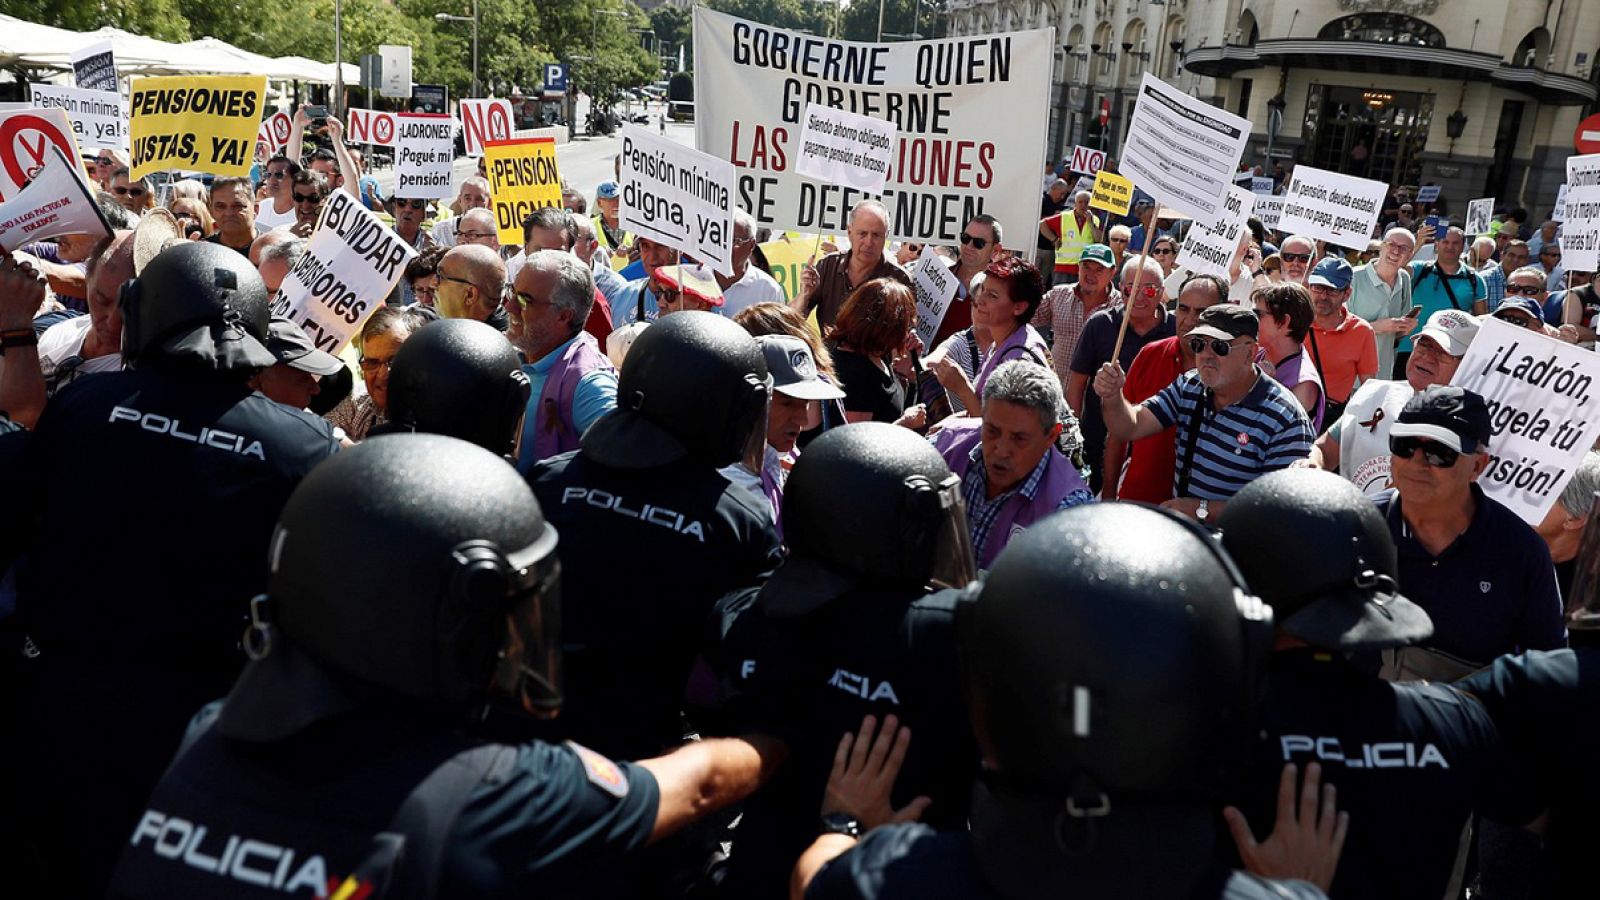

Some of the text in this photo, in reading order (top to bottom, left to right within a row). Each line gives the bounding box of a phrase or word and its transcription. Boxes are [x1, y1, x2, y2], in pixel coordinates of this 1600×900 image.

[548, 65, 563, 86] P
[733, 22, 1012, 89] GOBIERNE QUIEN
[33, 90, 120, 118] Pensión mínima
[131, 88, 257, 118] PENSIONES
[783, 77, 954, 134] GOBIERNE
[95, 120, 121, 139] ya!
[132, 132, 249, 169] JUSTAS, YA!
[350, 111, 395, 145] NO
[399, 122, 452, 143] ¡LADRONES!
[461, 101, 512, 157] NO
[807, 113, 833, 134] Siendo
[832, 121, 858, 142] ahorro
[399, 147, 452, 168] ¡Pagué mi
[491, 149, 559, 196] ¡PENSIÓN
[622, 136, 729, 211] Pensión mínima
[731, 120, 996, 190] LAS IONES
[1071, 147, 1104, 175] NO
[400, 172, 452, 190] pensión!
[737, 174, 779, 223] SE
[1298, 183, 1328, 206] pensión,
[496, 199, 562, 231] DIG
[623, 179, 729, 250] digna, ya!
[797, 181, 985, 241] DEFNDEN
[1256, 200, 1266, 210] LA
[317, 192, 406, 282] ¡BLINDAR
[293, 250, 367, 326] pensiones
[1482, 341, 1594, 408] ¡Ladrón,
[108, 405, 266, 461] POLICIA
[1486, 397, 1587, 453] ngela tú
[1485, 452, 1567, 497] nsión!
[561, 486, 705, 542] POLICIA
[741, 660, 900, 706] PICIA
[130, 809, 328, 900] POLICIA
